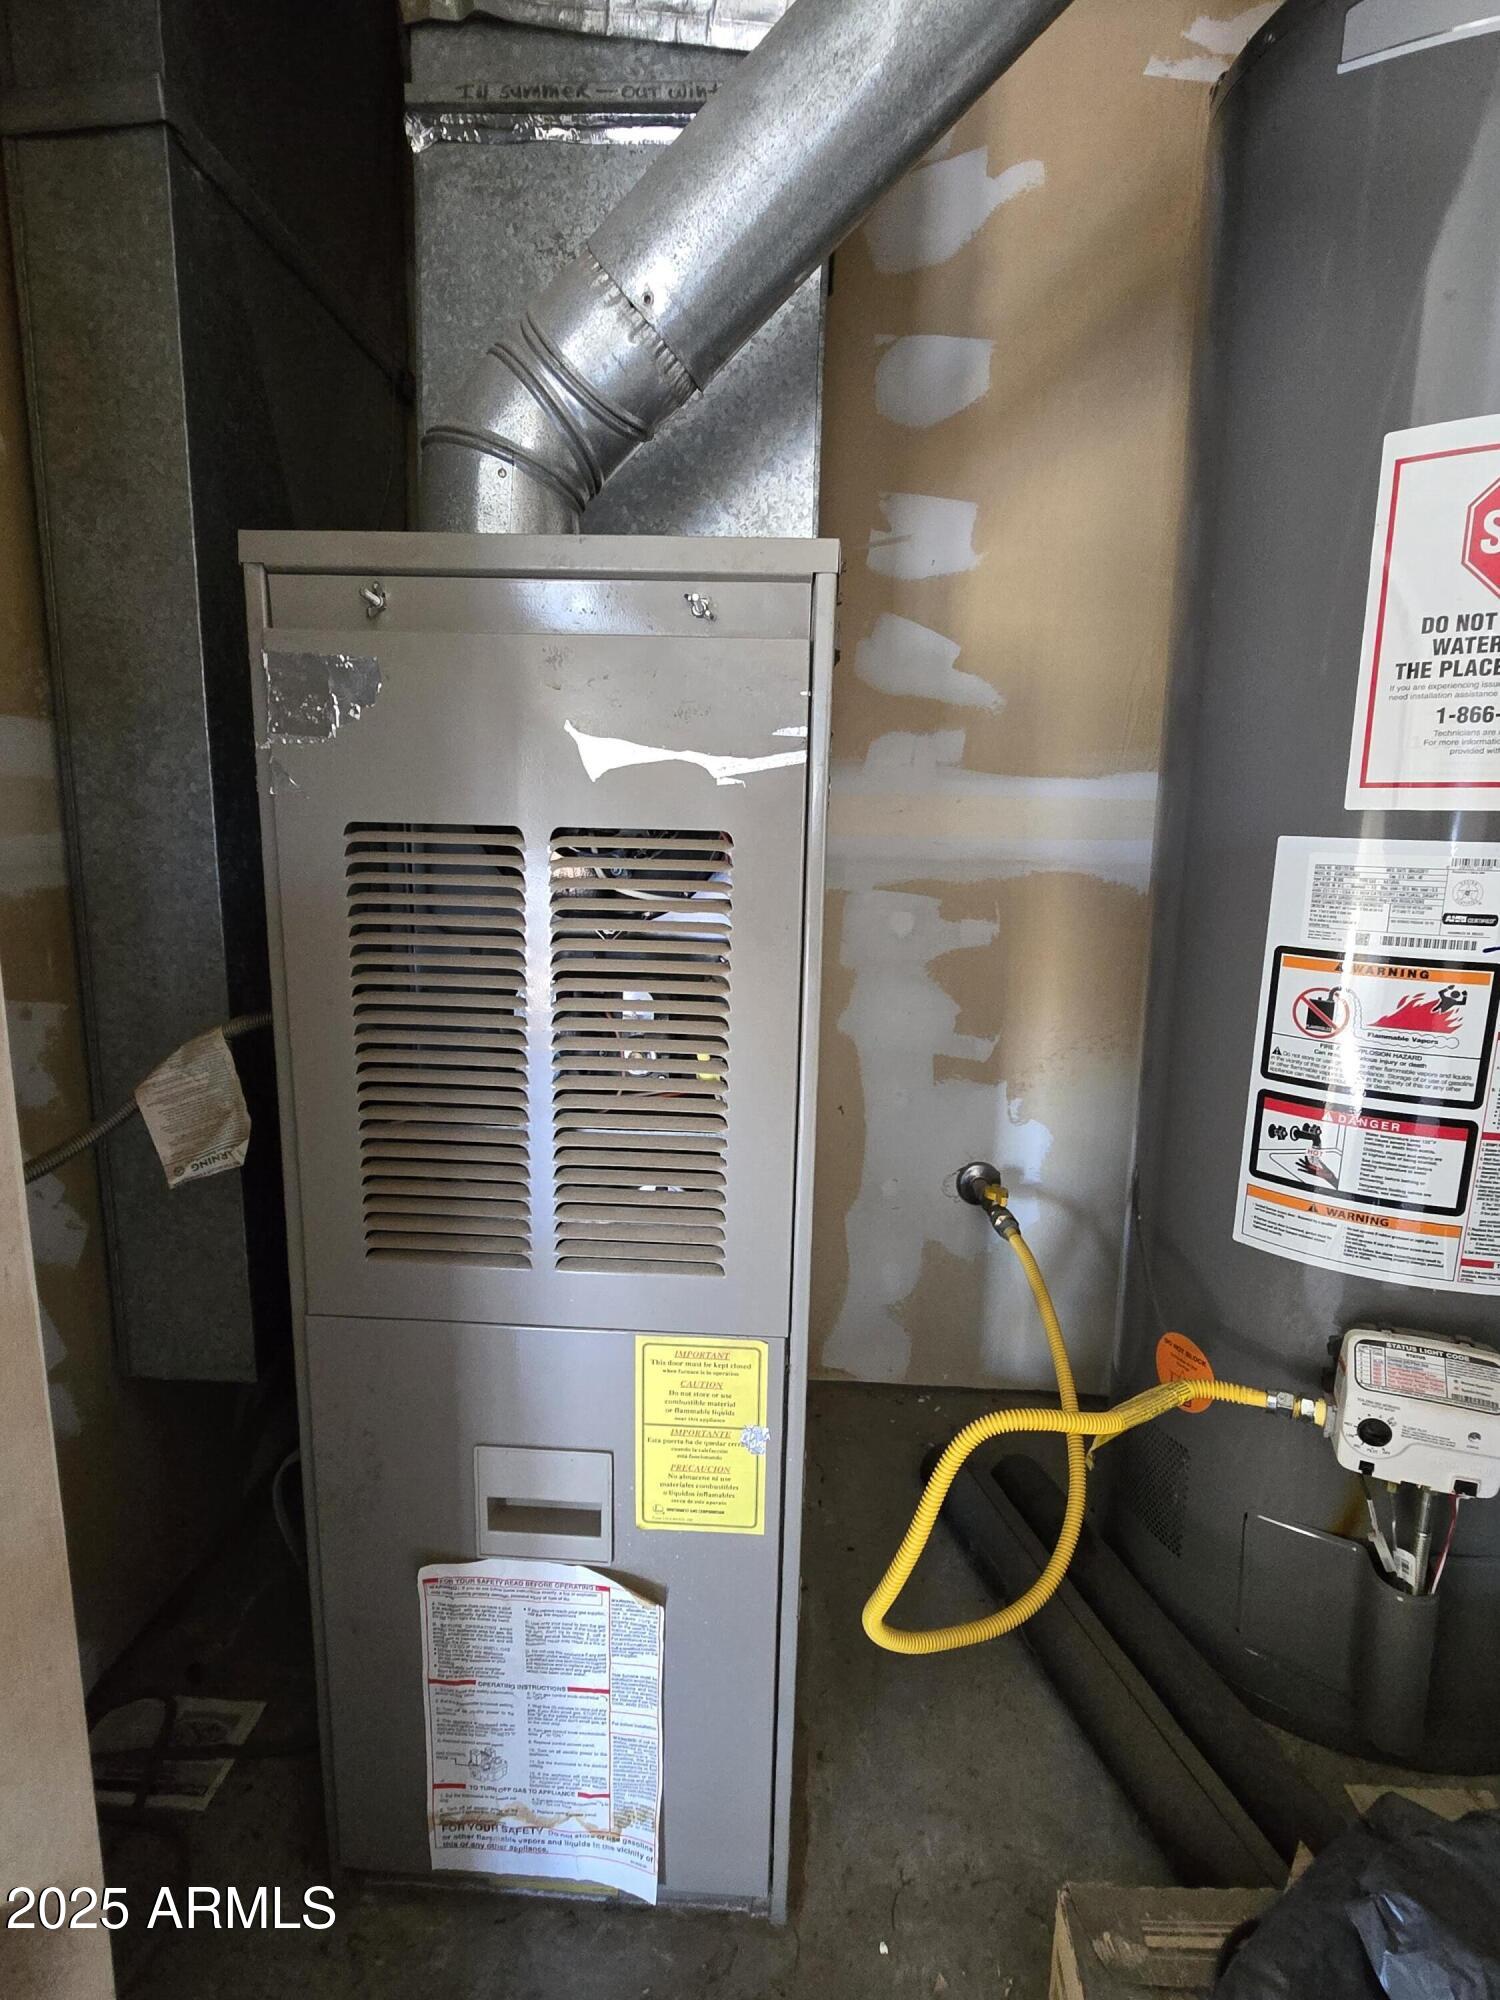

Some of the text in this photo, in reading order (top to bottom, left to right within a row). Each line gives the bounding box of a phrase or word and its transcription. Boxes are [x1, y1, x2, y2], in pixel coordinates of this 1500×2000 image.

[1421, 612, 1499, 634] DO NOT
[1432, 635, 1500, 656] WATER
[1395, 658, 1500, 680] THE PLACE
[1397, 684, 1411, 692] you
[1428, 681, 1480, 690] experiencing
[1353, 962, 1430, 980] WARNING
[1367, 1031, 1439, 1045] Flammable Vapors
[1393, 1052, 1423, 1062] HAZARD
[1408, 1061, 1427, 1069] death
[1337, 1114, 1401, 1132] DANGER
[1307, 1148, 1323, 1157] HOT
[1325, 1206, 1390, 1227] WARNING
[674, 1350, 730, 1360] IMPORTANT
[1386, 1342, 1470, 1361] STATUS LIGHT CODE
[667, 1359, 683, 1367] door
[713, 1361, 729, 1370] kept
[680, 1380, 724, 1390] CAUTION
[707, 1400, 736, 1408] material
[674, 1407, 711, 1415] flammable
[711, 1409, 735, 1417] liquids
[670, 1428, 732, 1439] IMPORTANTE
[659, 1481, 739, 1491] materiales combustibles
[439, 1576, 594, 1591] FOR YOUR SAFETY READ BEFORE OPERATING
[478, 1681, 566, 1692] OPERATING INSTRUCTIONS
[538, 1789, 576, 1798] APPLIANCE
[442, 1823, 465, 1832] FOR
[467, 1823, 499, 1833] YOUR
[501, 1825, 544, 1835] SAFETY
[622, 1838, 653, 1853] gasoline
[469, 1842, 485, 1850] any
[564, 1840, 591, 1849] liquids
[616, 1846, 645, 1860] vicinity
